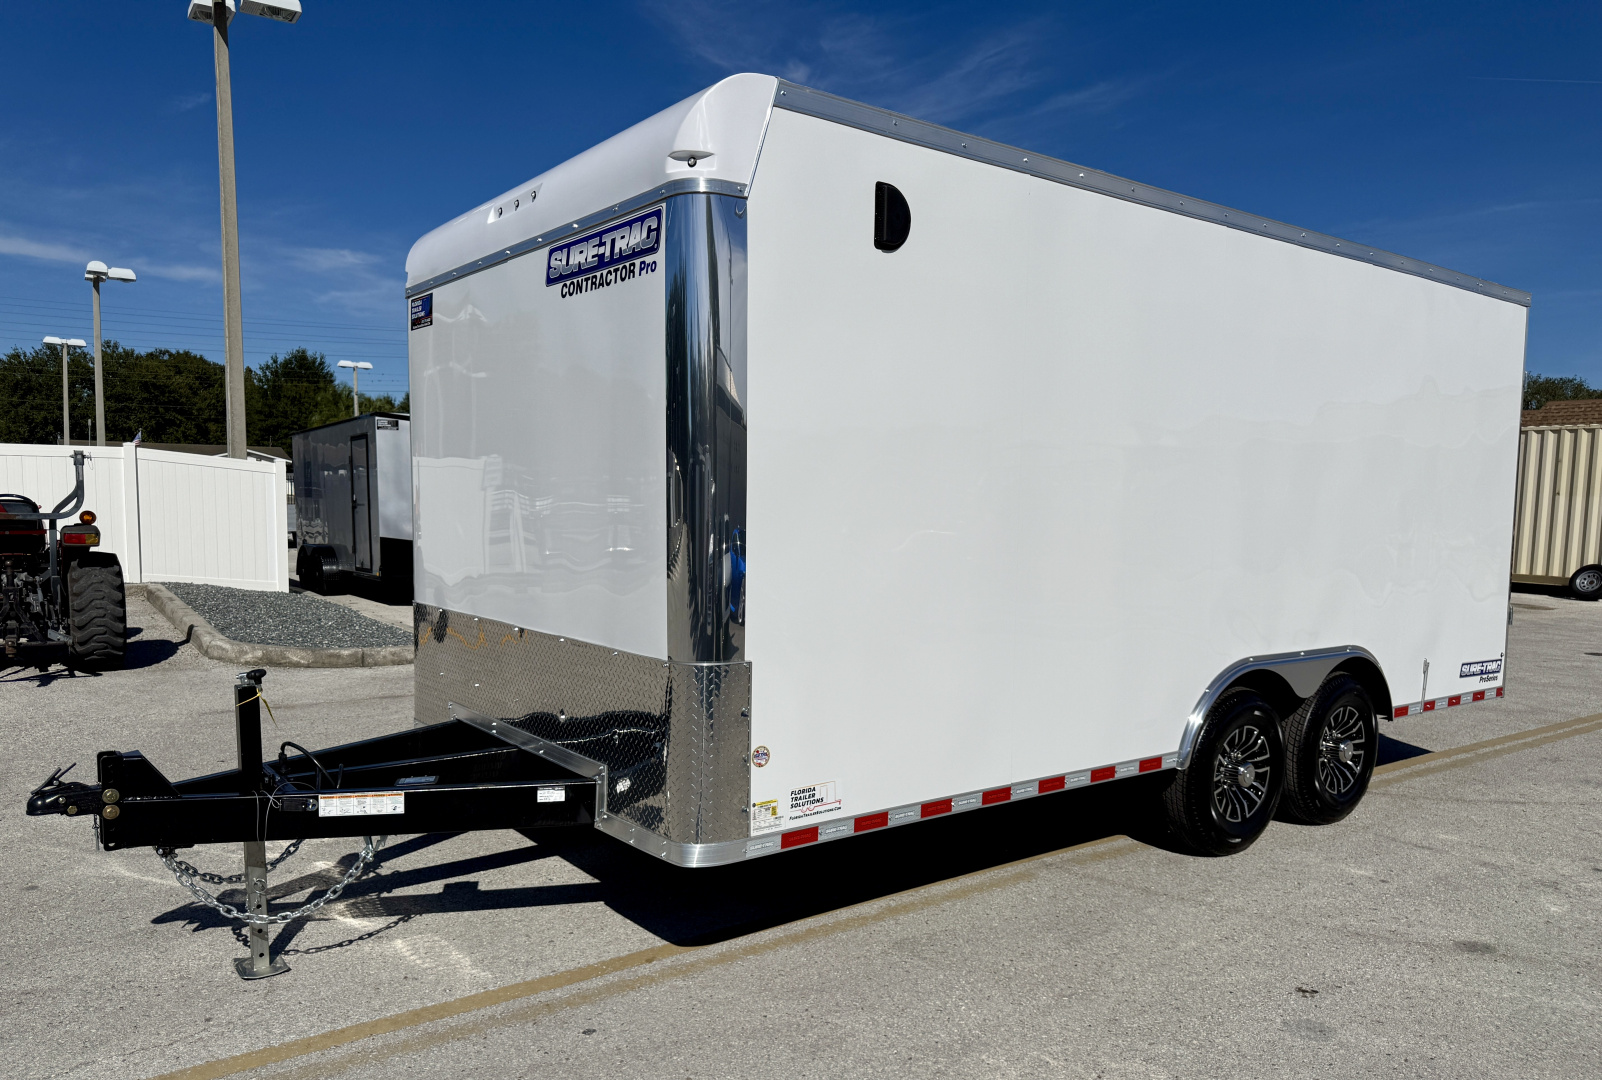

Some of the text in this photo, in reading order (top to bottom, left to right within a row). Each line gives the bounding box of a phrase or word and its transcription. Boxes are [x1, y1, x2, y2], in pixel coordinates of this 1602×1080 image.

[549, 216, 658, 279] SURE-TRAC
[560, 260, 657, 298] CONTRACTOR Pro
[1461, 660, 1501, 676] SURE-TRAC
[790, 787, 816, 797] FLORIDA
[790, 793, 816, 803] TRAILER
[790, 797, 824, 809] SOLUTIONS
